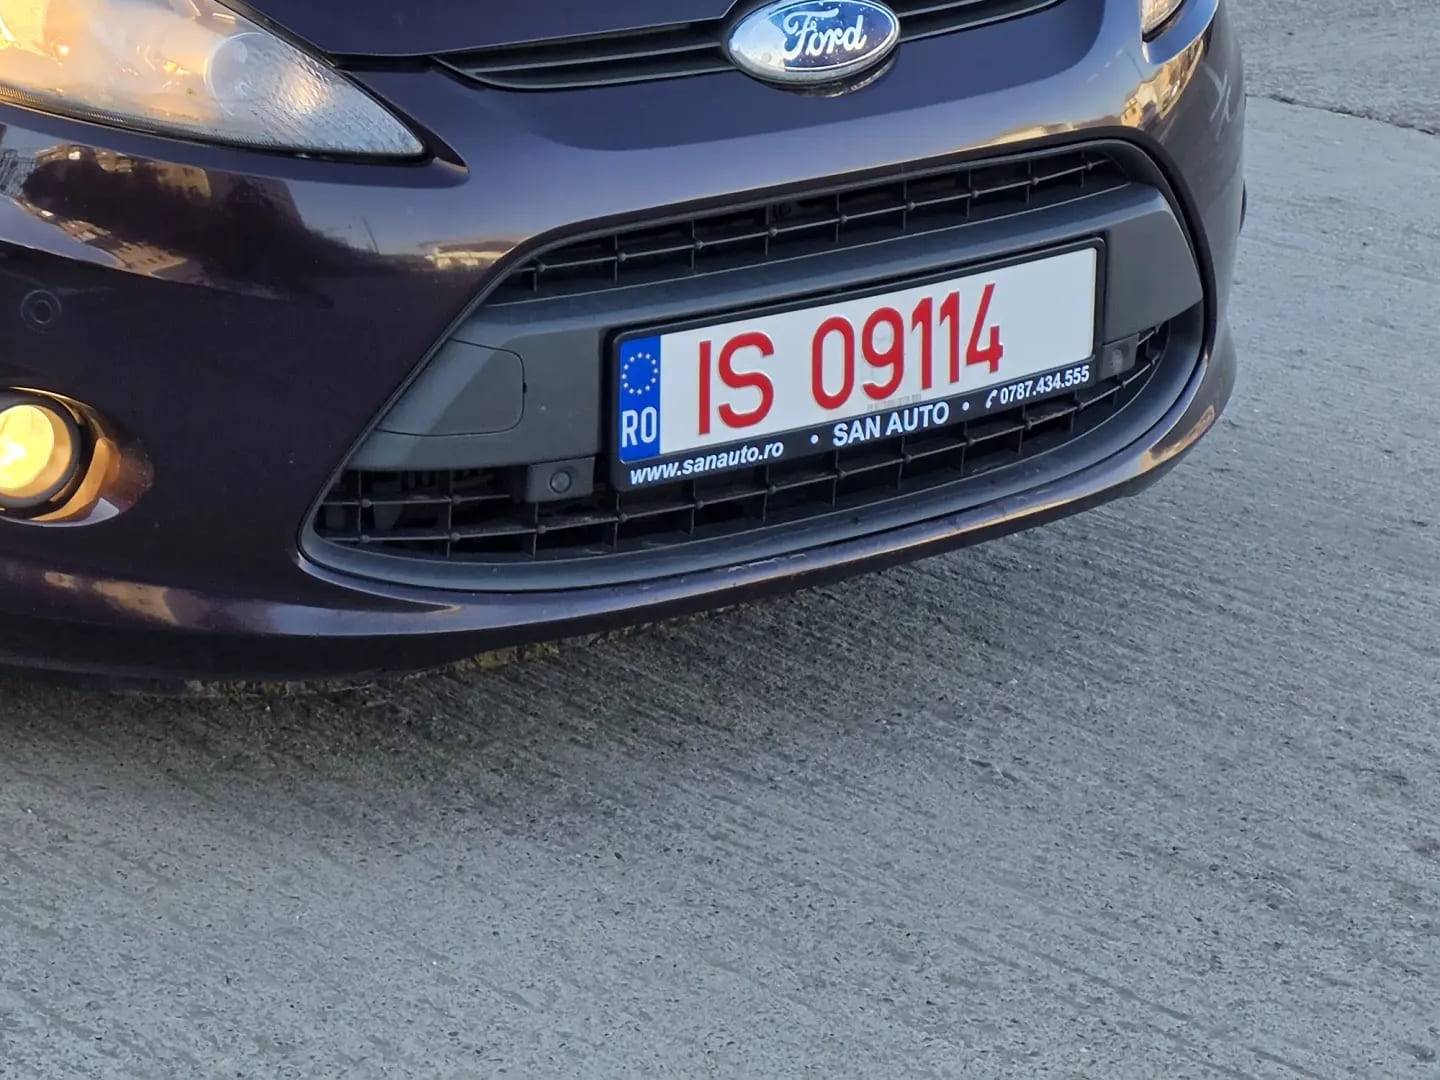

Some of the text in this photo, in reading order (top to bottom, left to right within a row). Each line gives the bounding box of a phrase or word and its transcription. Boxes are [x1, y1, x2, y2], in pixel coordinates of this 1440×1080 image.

[782, 8, 867, 60] Ford
[698, 282, 1003, 435] IS 09114
[622, 406, 657, 448] RO
[630, 441, 784, 485] www.sanauto.ro
[833, 416, 880, 447] SAN
[885, 401, 950, 436] AUTO
[999, 365, 1090, 405] 0787.434.555
